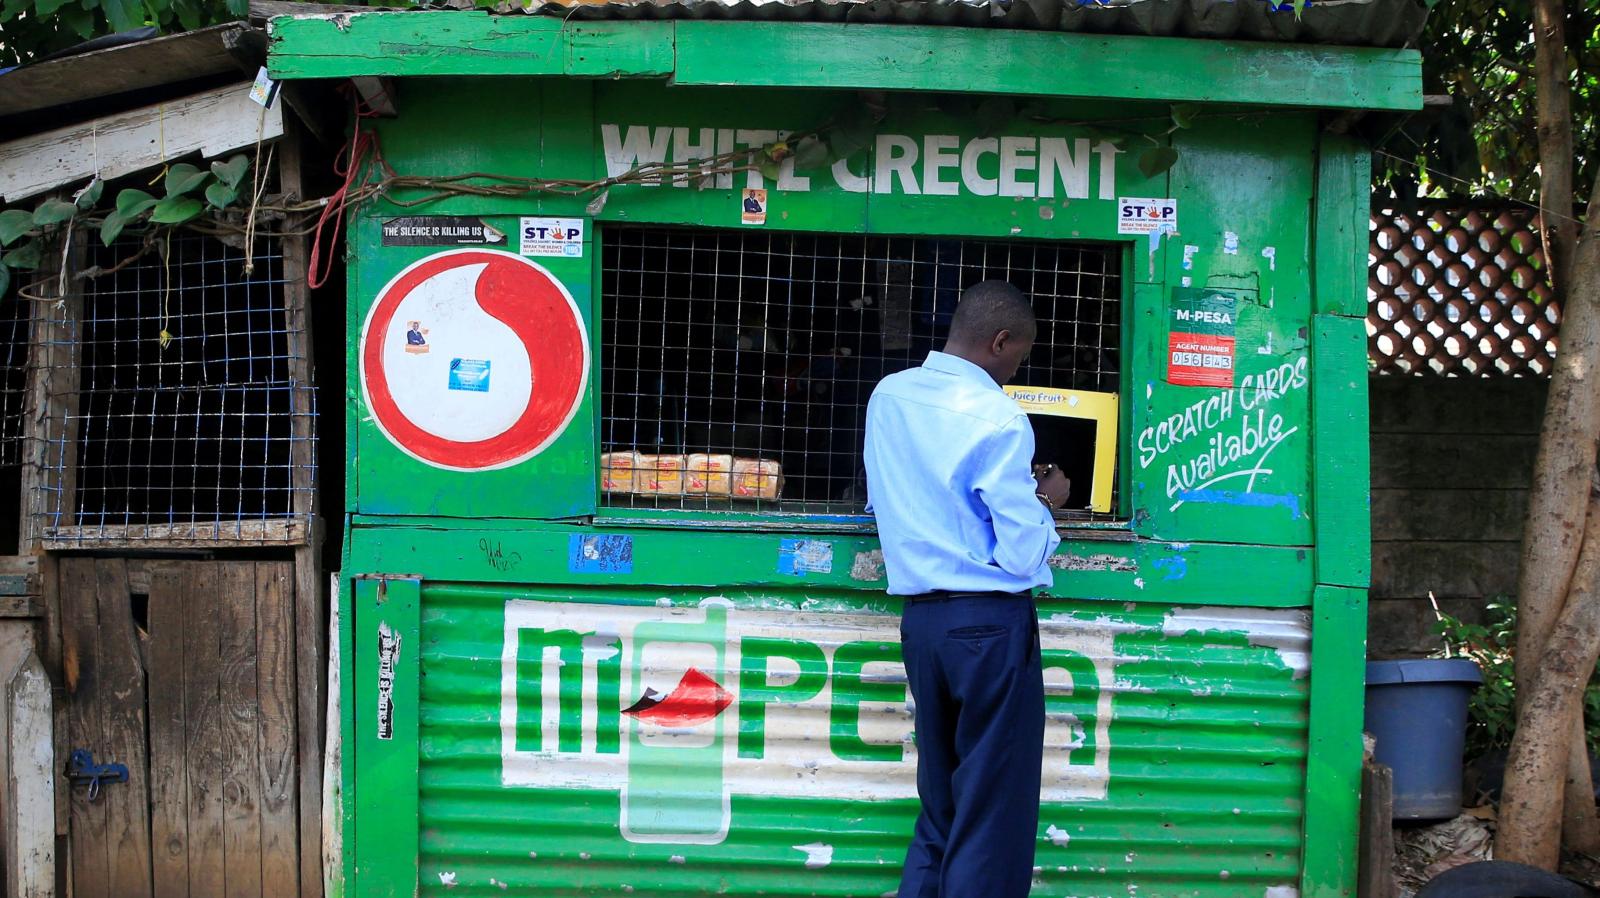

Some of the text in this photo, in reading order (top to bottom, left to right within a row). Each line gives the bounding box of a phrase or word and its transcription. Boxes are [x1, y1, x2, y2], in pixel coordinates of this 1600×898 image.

[384, 226, 482, 236] THE SILENCE IS KILLING US
[1176, 309, 1232, 324] M-PESA
[1199, 345, 1230, 353] NUMBER
[1012, 391, 1061, 403] Juicy Fruit
[1138, 356, 1308, 469] SCRATCH CARDS
